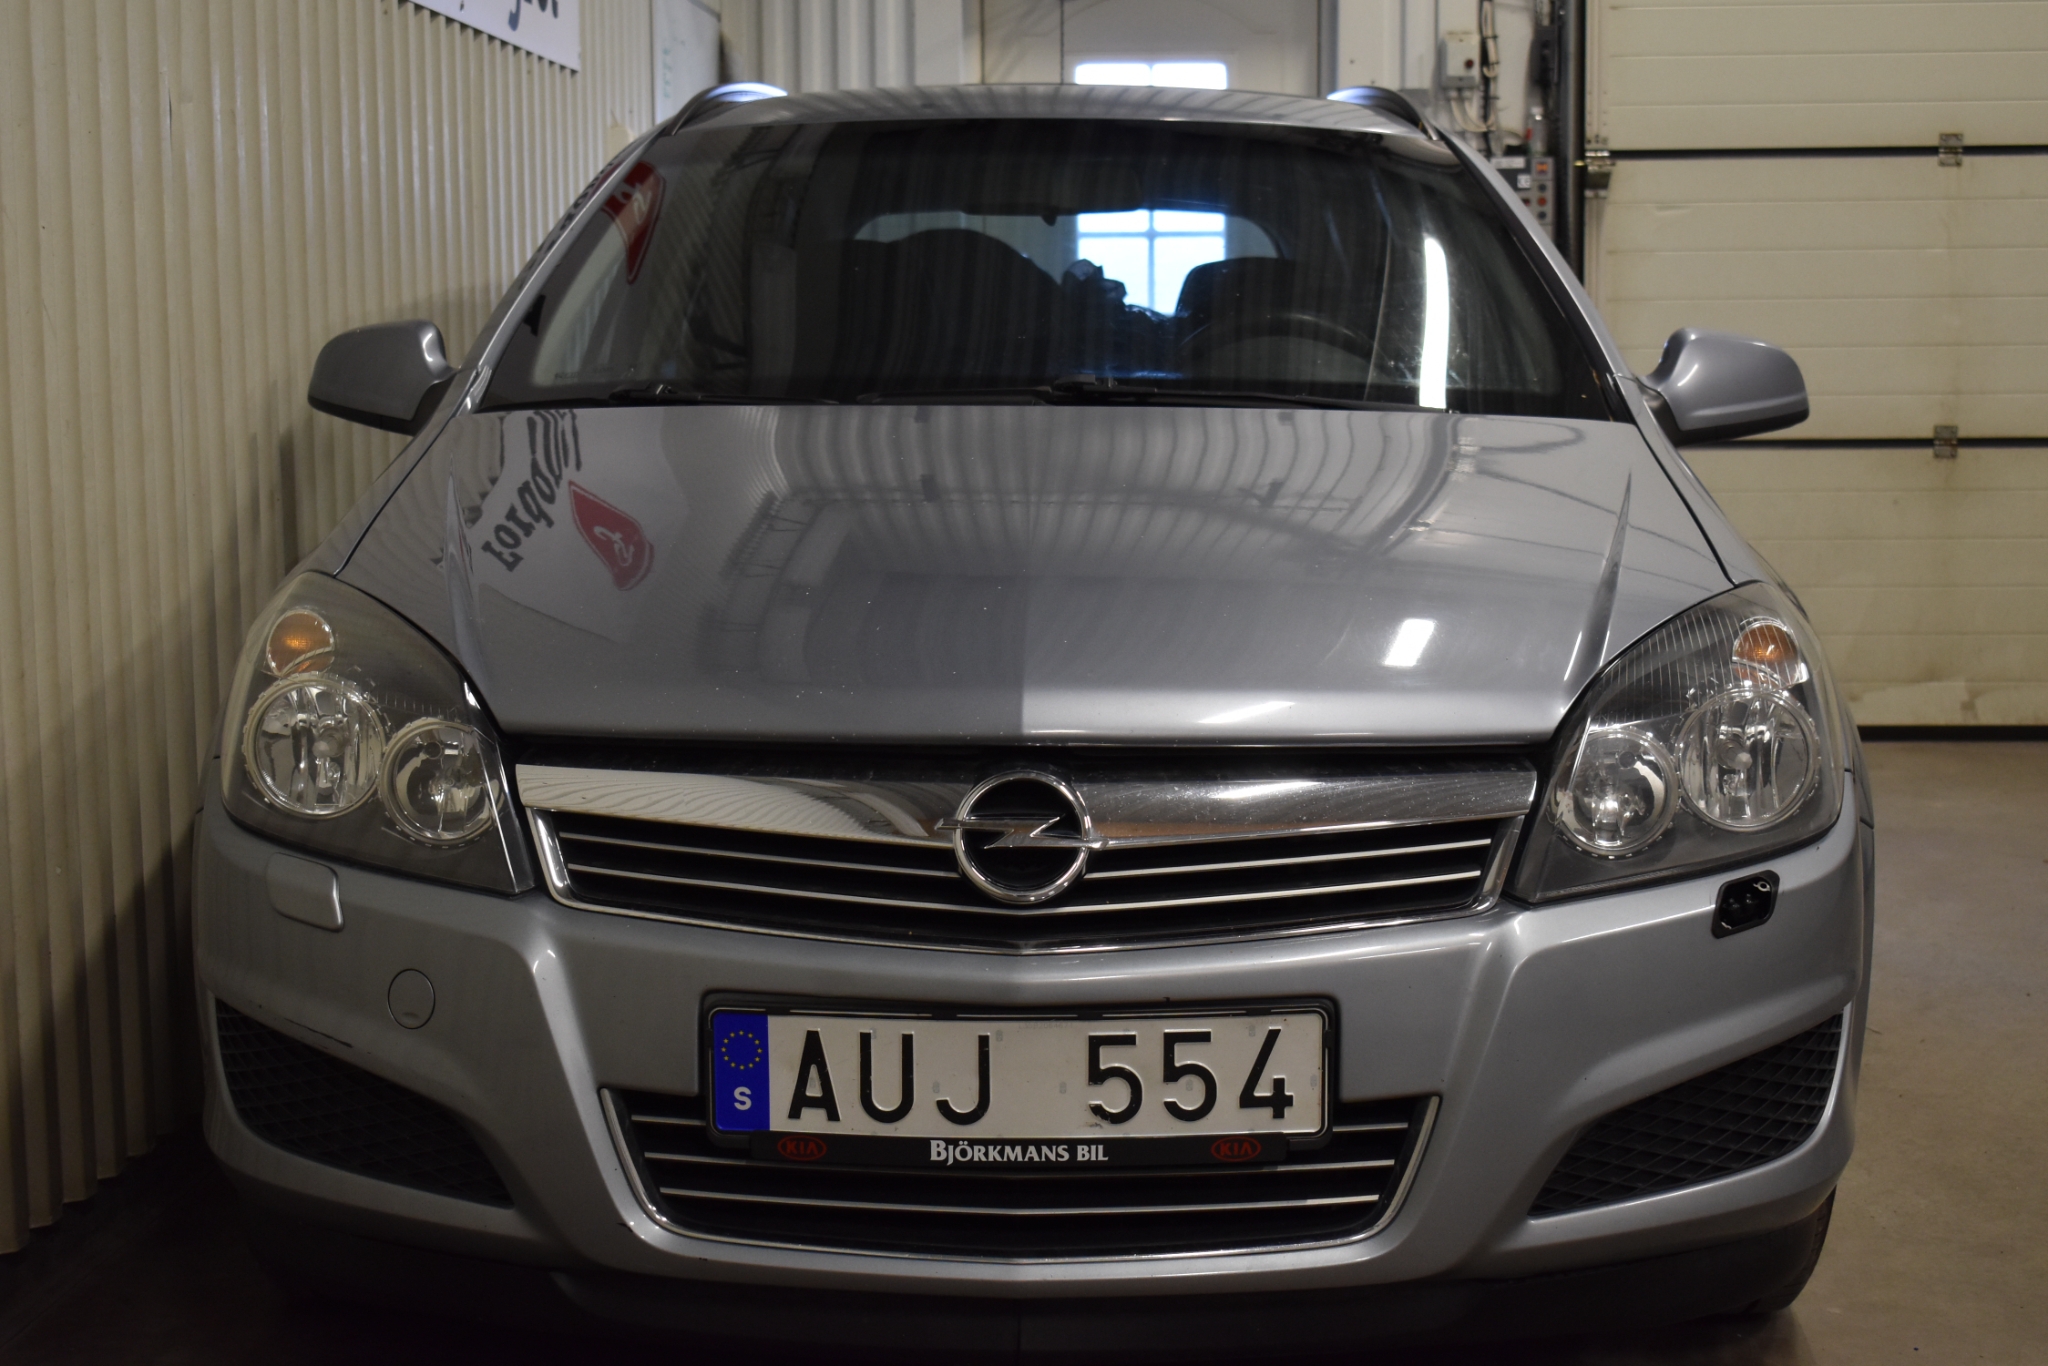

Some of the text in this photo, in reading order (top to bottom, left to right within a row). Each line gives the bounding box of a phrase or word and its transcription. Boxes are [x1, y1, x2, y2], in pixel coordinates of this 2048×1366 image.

[787, 1026, 1294, 1126] AUJ 554
[733, 1086, 752, 1111] S
[1076, 1144, 1109, 1161] BIL
